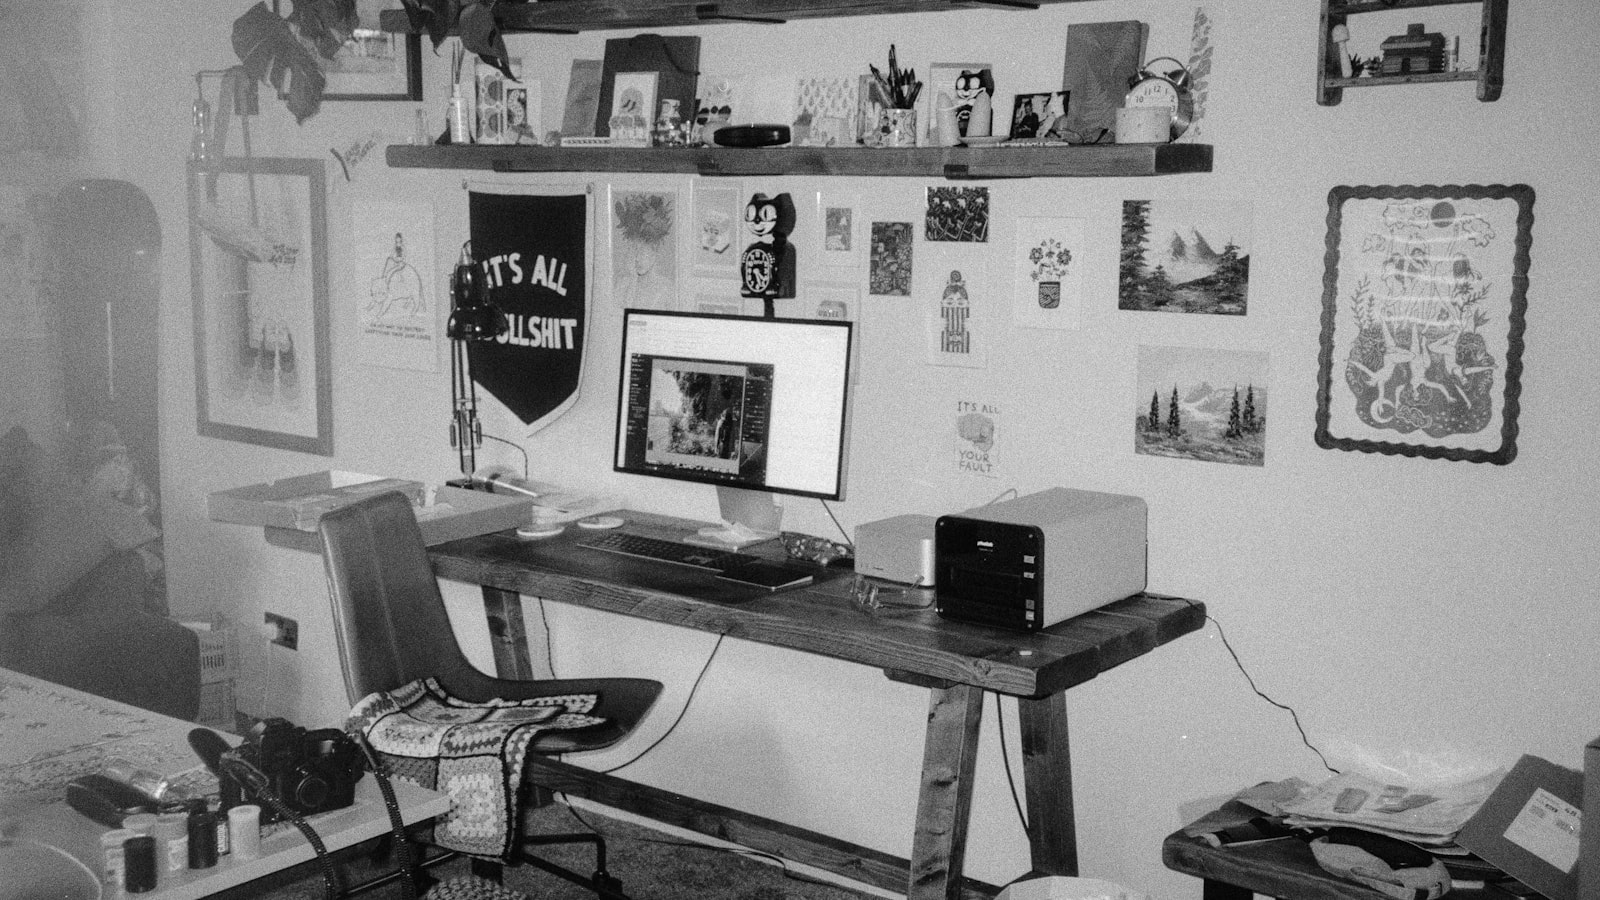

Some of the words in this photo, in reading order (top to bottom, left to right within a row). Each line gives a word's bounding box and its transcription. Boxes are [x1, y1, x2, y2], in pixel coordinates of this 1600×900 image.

[482, 252, 523, 289] IT'S
[531, 254, 567, 296] ALL
[484, 314, 577, 349] LLSHIT
[982, 404, 999, 414] ALL
[959, 450, 989, 462] YOUR
[959, 460, 992, 473] FAULT
